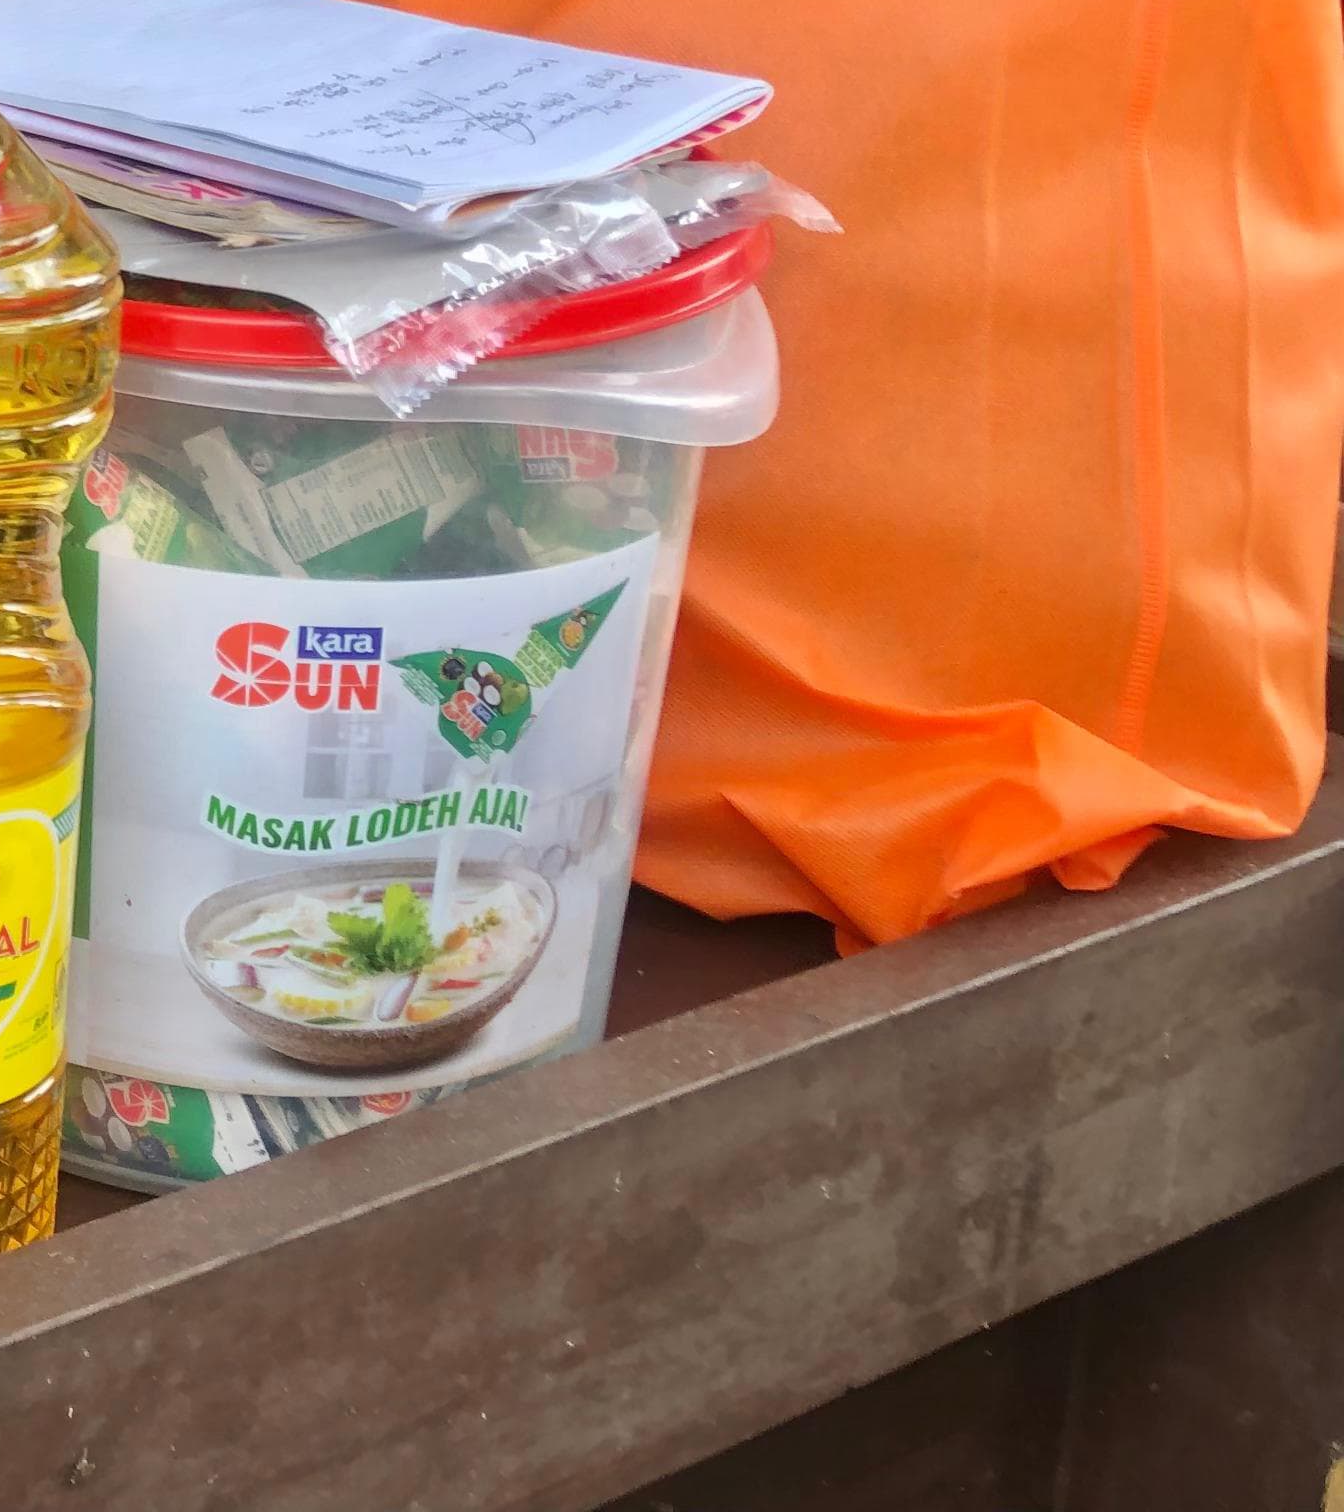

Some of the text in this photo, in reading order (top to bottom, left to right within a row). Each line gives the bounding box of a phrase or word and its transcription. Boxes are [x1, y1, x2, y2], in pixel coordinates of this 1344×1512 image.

[209, 621, 382, 713] SUN
[303, 627, 375, 659] kara
[206, 786, 530, 851] MASAK LODEH AJA!
